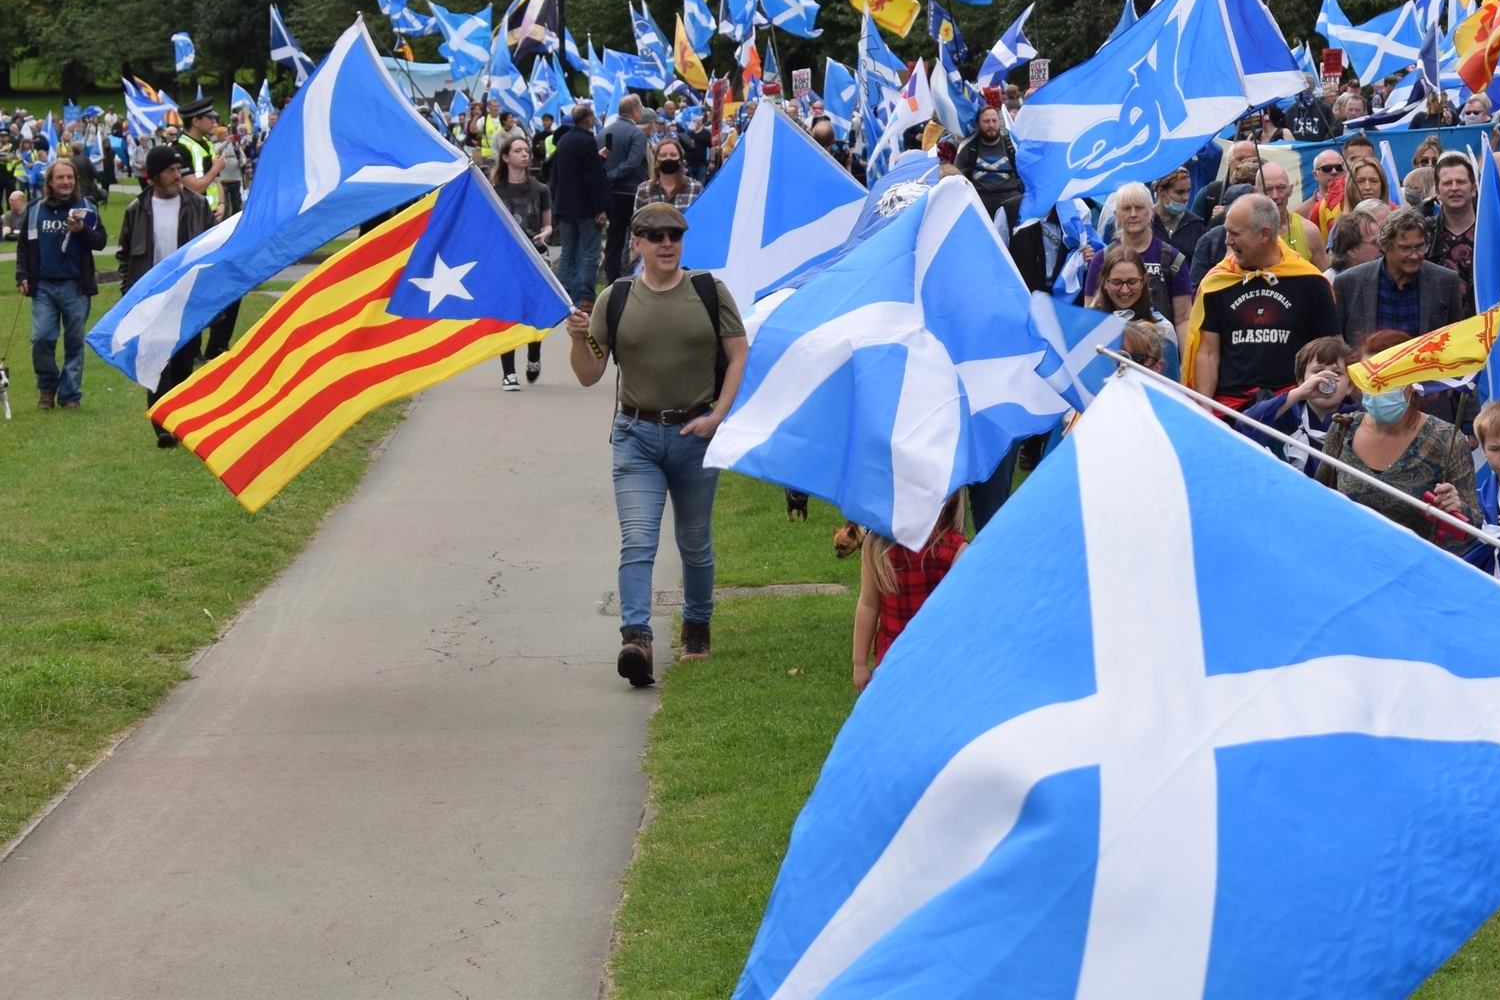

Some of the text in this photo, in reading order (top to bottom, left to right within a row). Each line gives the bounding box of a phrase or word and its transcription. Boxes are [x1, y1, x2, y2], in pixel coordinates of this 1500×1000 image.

[1031, 73, 1047, 81] RULE
[43, 220, 69, 230] BOS
[1230, 289, 1292, 310] PEOPLE'S REPUBLIC
[1231, 328, 1291, 345] GLASGOW
